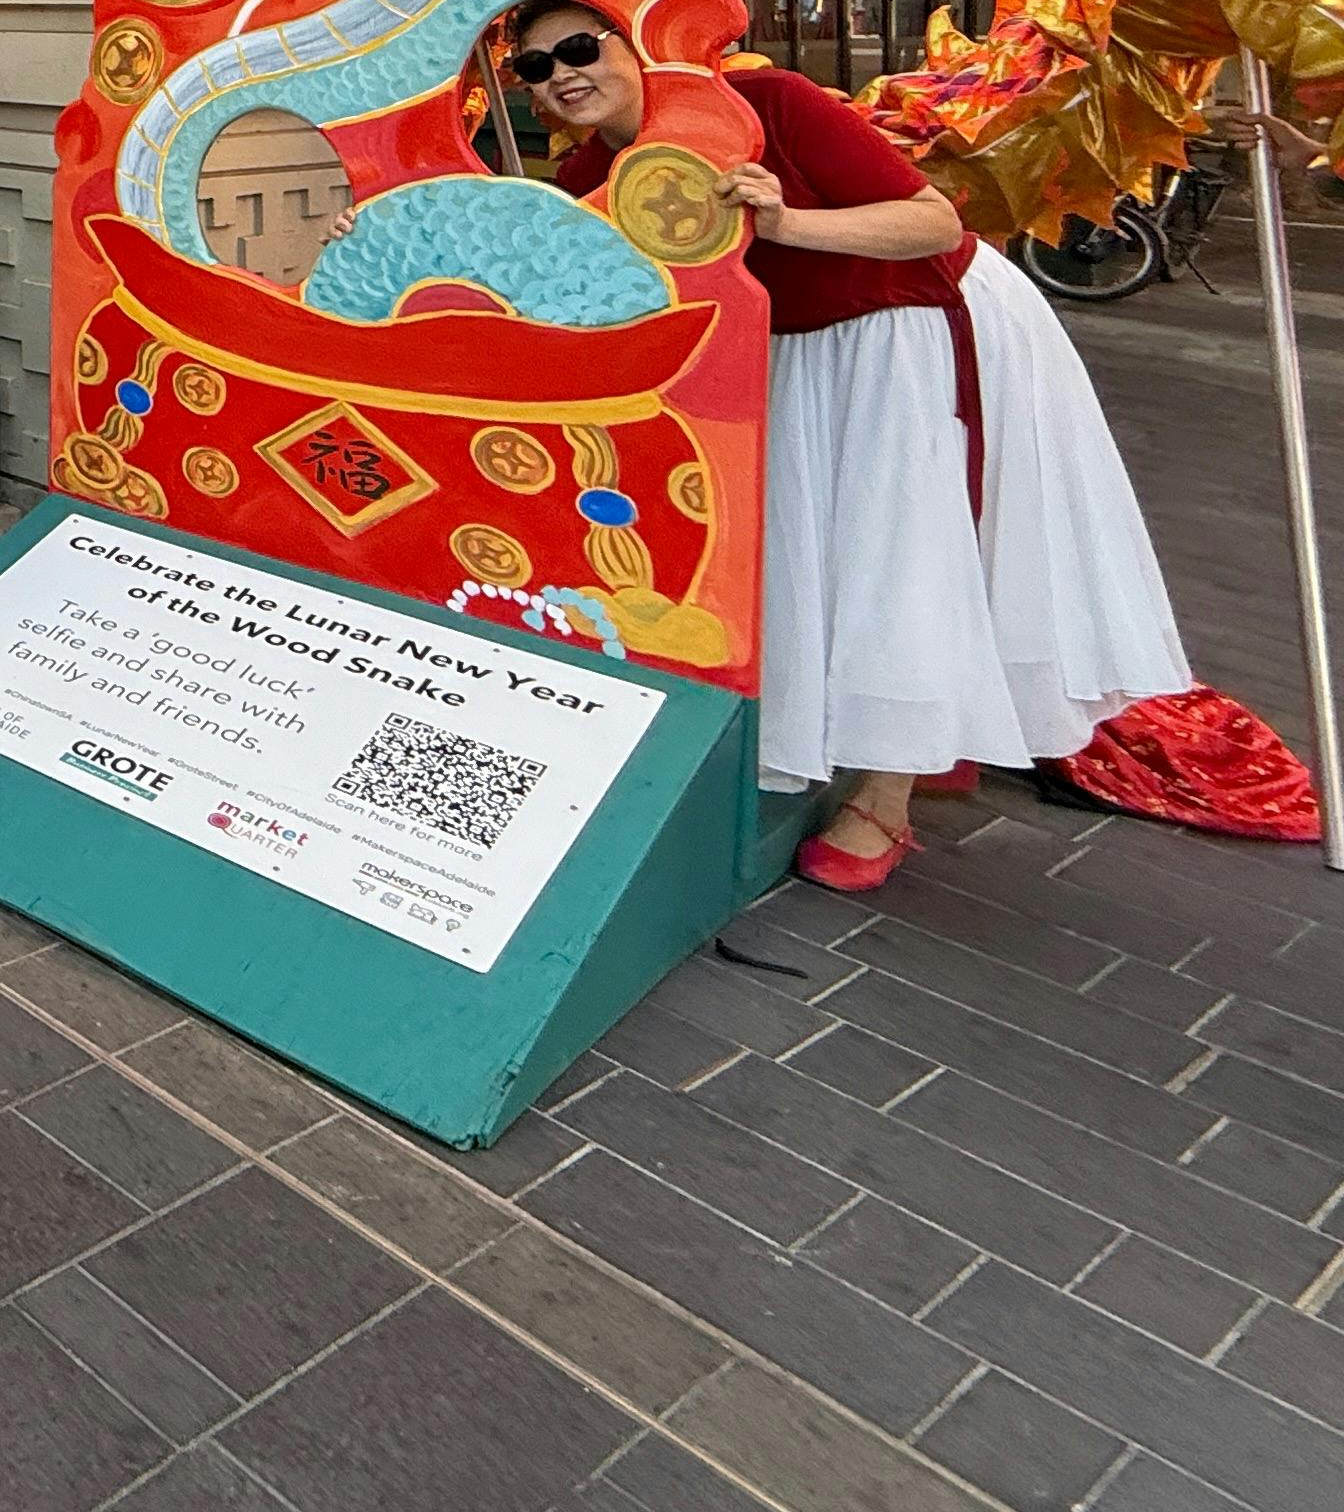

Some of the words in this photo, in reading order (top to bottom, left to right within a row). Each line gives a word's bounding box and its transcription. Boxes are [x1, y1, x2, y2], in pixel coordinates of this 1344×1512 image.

[300, 430, 390, 500] 福
[58, 599, 118, 633] Take
[122, 626, 140, 641] a
[68, 535, 216, 592] Celebrate
[222, 584, 279, 612] the
[284, 602, 392, 647] Lunar
[396, 639, 495, 680] New
[505, 669, 606, 715] Year
[127, 585, 165, 607] of
[166, 596, 222, 624] the
[230, 616, 342, 665] Wood
[343, 656, 467, 709] Snake
[7, 641, 90, 684] family
[90, 676, 153, 709] and
[153, 697, 263, 754] friends.
[17, 616, 87, 651] selfie
[90, 643, 148, 674] and
[150, 662, 233, 707] share
[240, 698, 307, 735] with
[2, 710, 25, 724] OF
[4, 687, 74, 722] #ChinatownSA
[79, 719, 162, 758] #LunarNewYear
[167, 756, 240, 793] #GroteStreet
[246, 789, 343, 835] #CityOfAdelaide
[350, 833, 498, 899] #MakerspaceAdelaide
[71, 739, 175, 792] GROTE
[217, 800, 309, 847] market
[324, 792, 364, 817] Scan
[367, 810, 407, 833] here
[409, 825, 433, 843] for
[436, 838, 484, 862] more
[361, 861, 475, 915] makerspace
